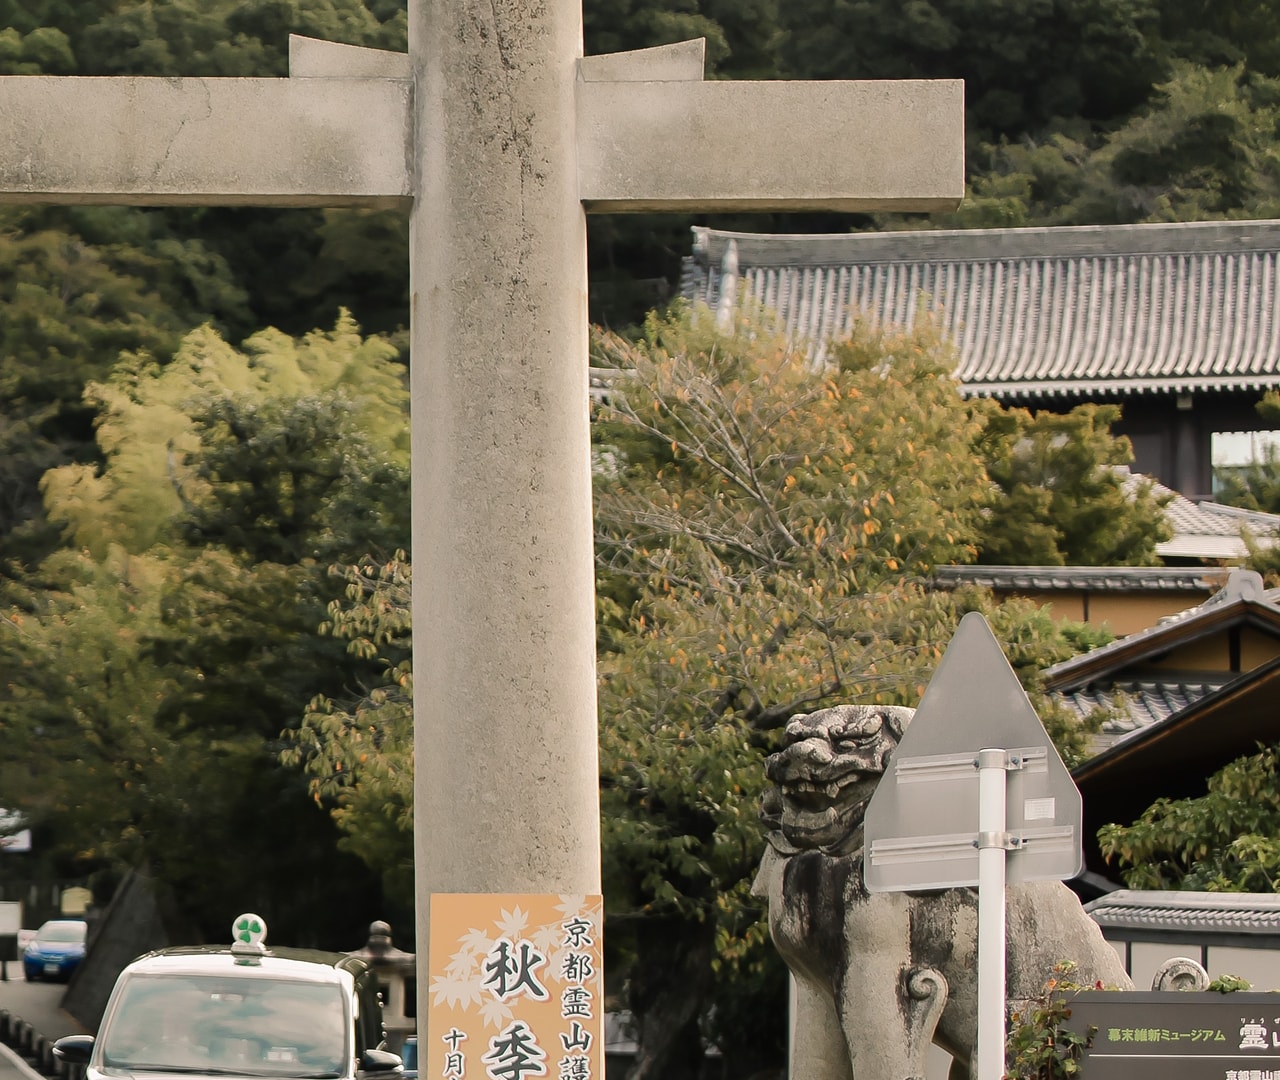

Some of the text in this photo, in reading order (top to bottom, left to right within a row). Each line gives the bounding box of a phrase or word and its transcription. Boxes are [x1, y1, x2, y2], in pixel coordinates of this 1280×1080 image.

[1108, 1028, 1226, 1042] 幕末維新ミュージアム
